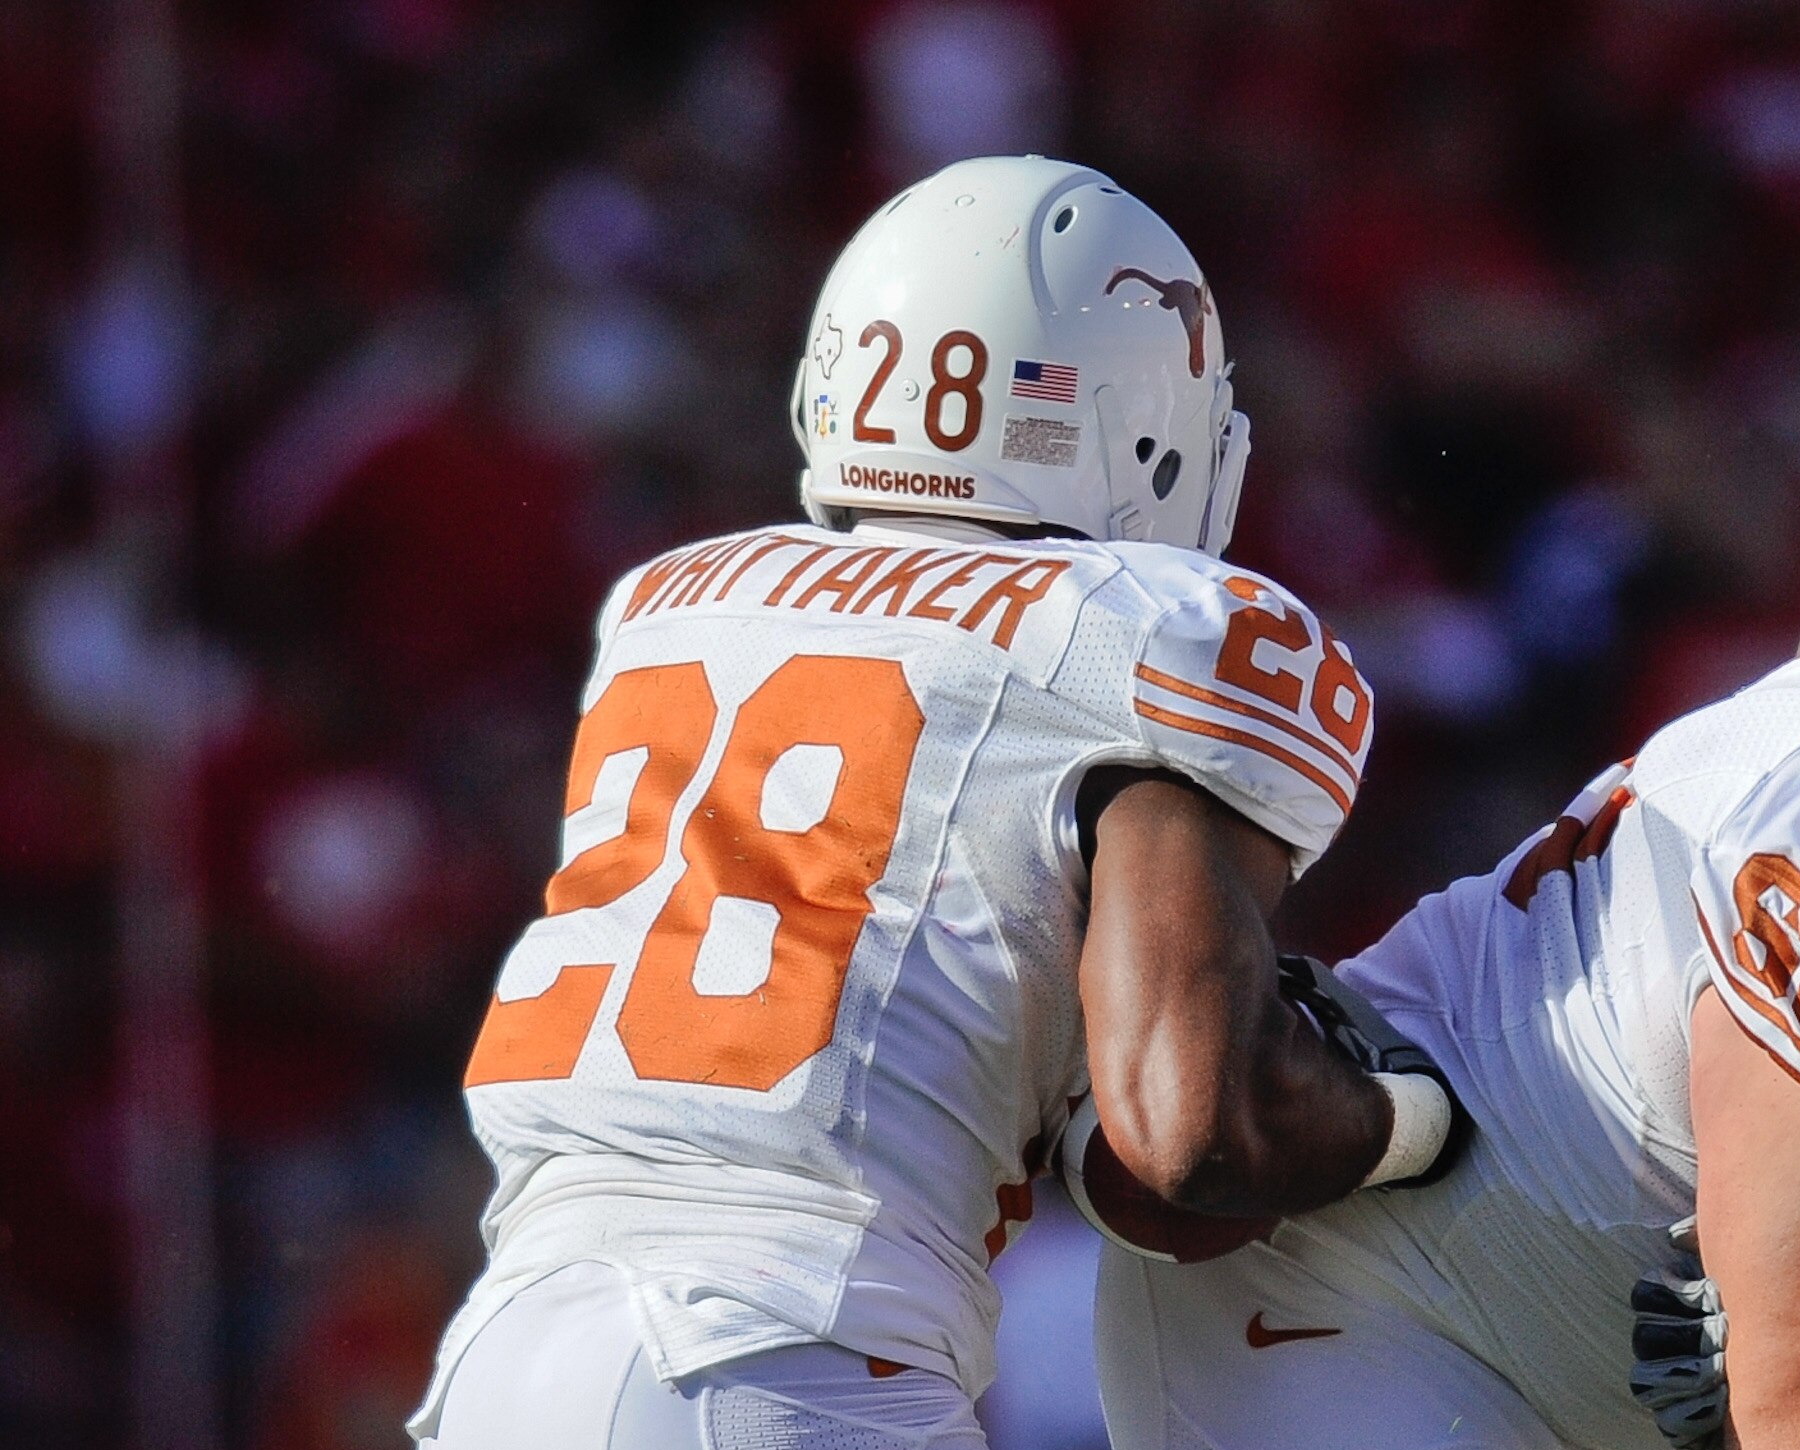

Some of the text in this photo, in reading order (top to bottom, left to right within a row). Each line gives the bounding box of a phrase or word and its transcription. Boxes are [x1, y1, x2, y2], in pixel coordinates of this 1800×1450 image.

[852, 319, 989, 452] 28
[840, 463, 975, 499] LONGHORNS
[623, 533, 1072, 651] WHITTAKER
[1215, 576, 1370, 756] 28
[464, 654, 926, 1091] 28
